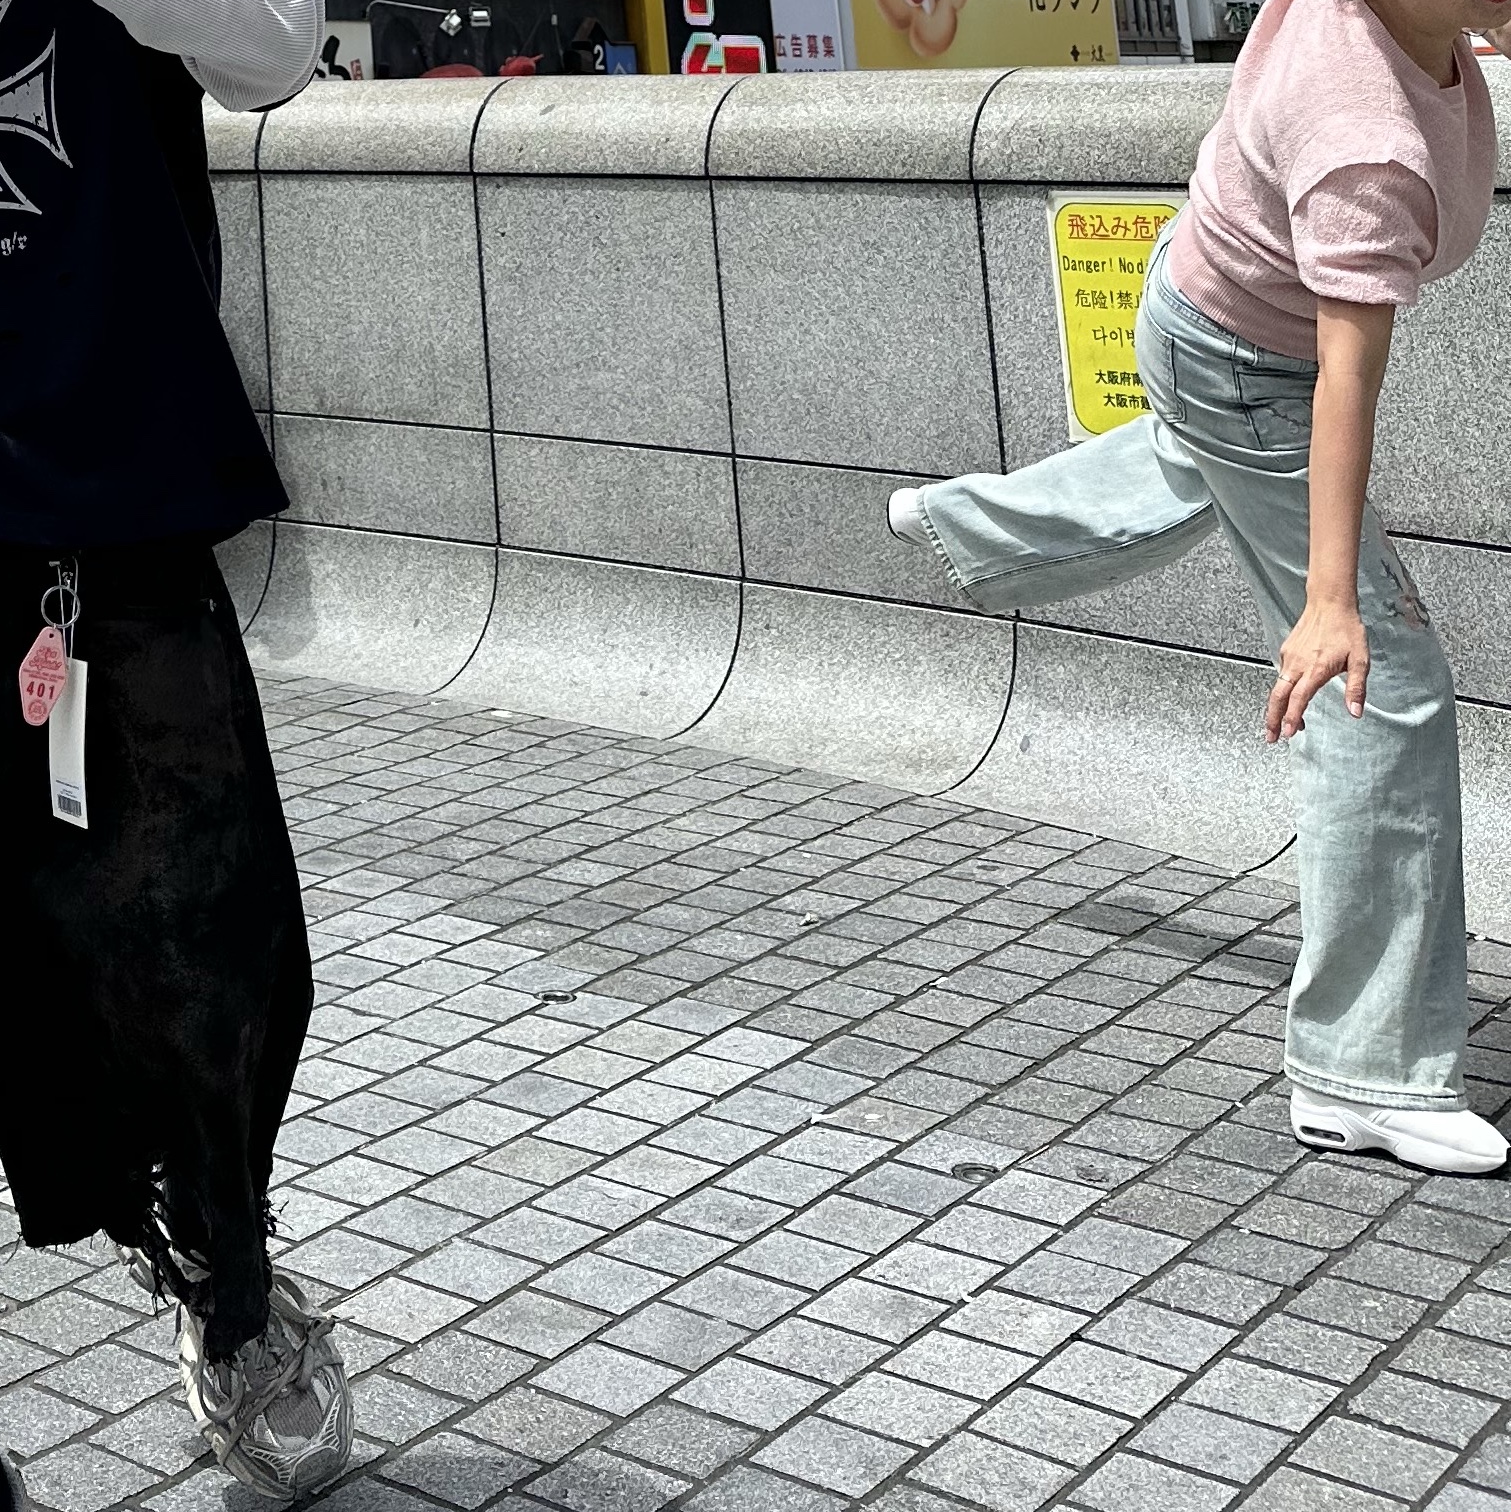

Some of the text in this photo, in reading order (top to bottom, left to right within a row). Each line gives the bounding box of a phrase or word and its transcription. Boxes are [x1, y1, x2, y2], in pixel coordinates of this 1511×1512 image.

[1063, 256, 1114, 273] Danger!
[1119, 257, 1134, 274] No
[26, 681, 55, 700] 401
